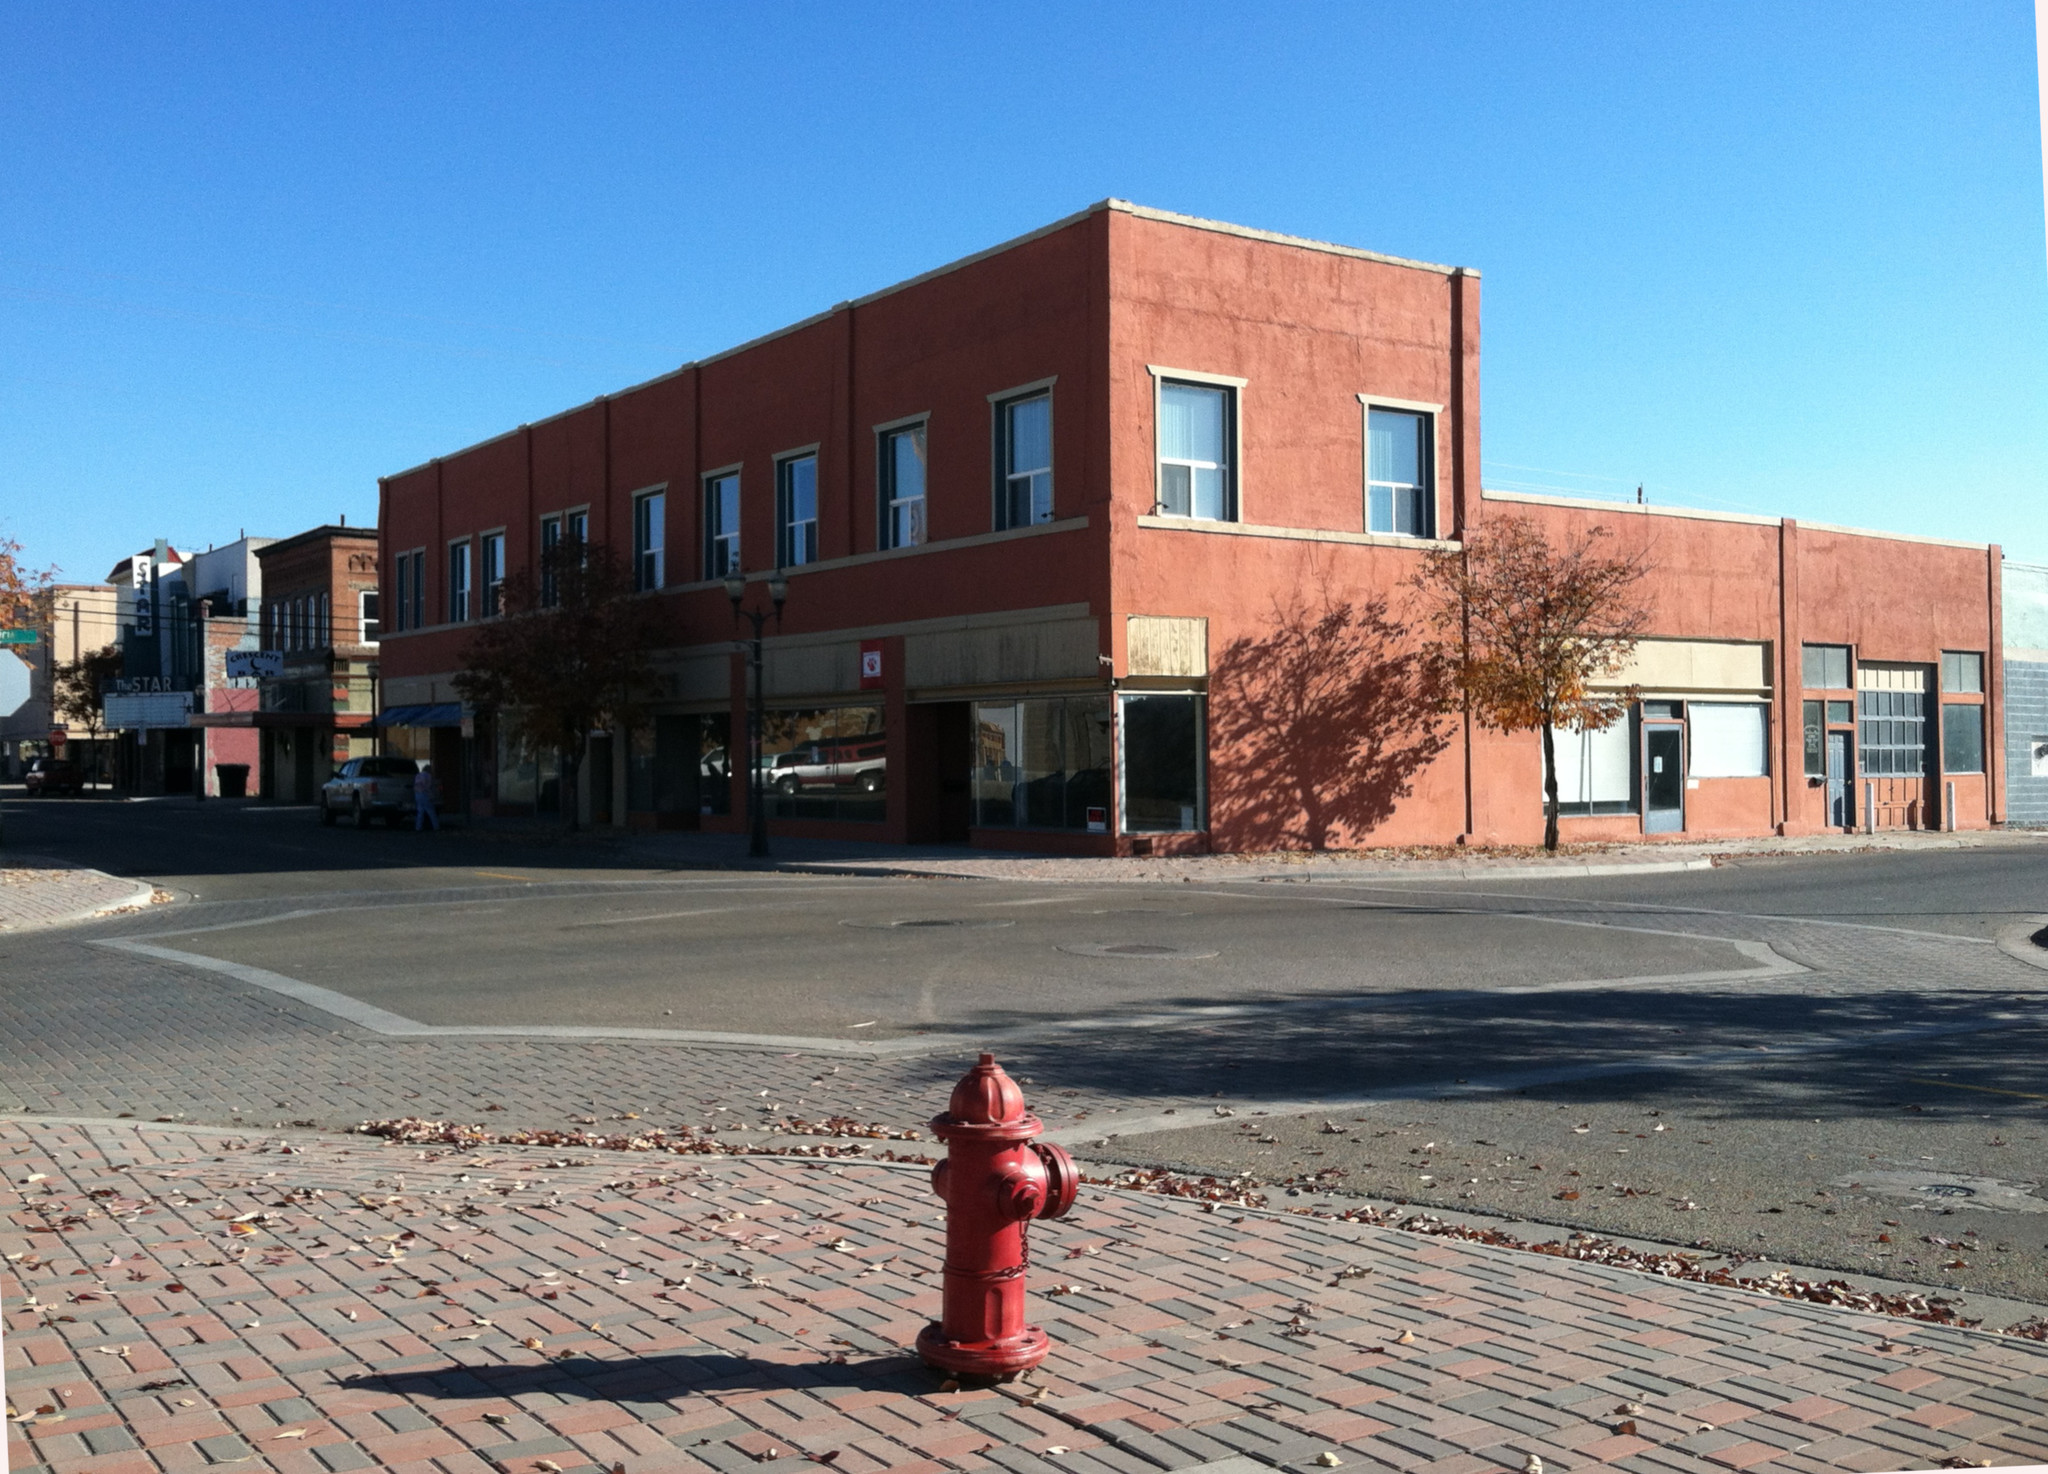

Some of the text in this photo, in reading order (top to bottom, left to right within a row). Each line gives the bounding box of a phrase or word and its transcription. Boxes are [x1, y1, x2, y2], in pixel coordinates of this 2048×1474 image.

[136, 562, 150, 632] STAR
[230, 651, 281, 663] CRESCENT
[116, 676, 172, 692] The STAR
